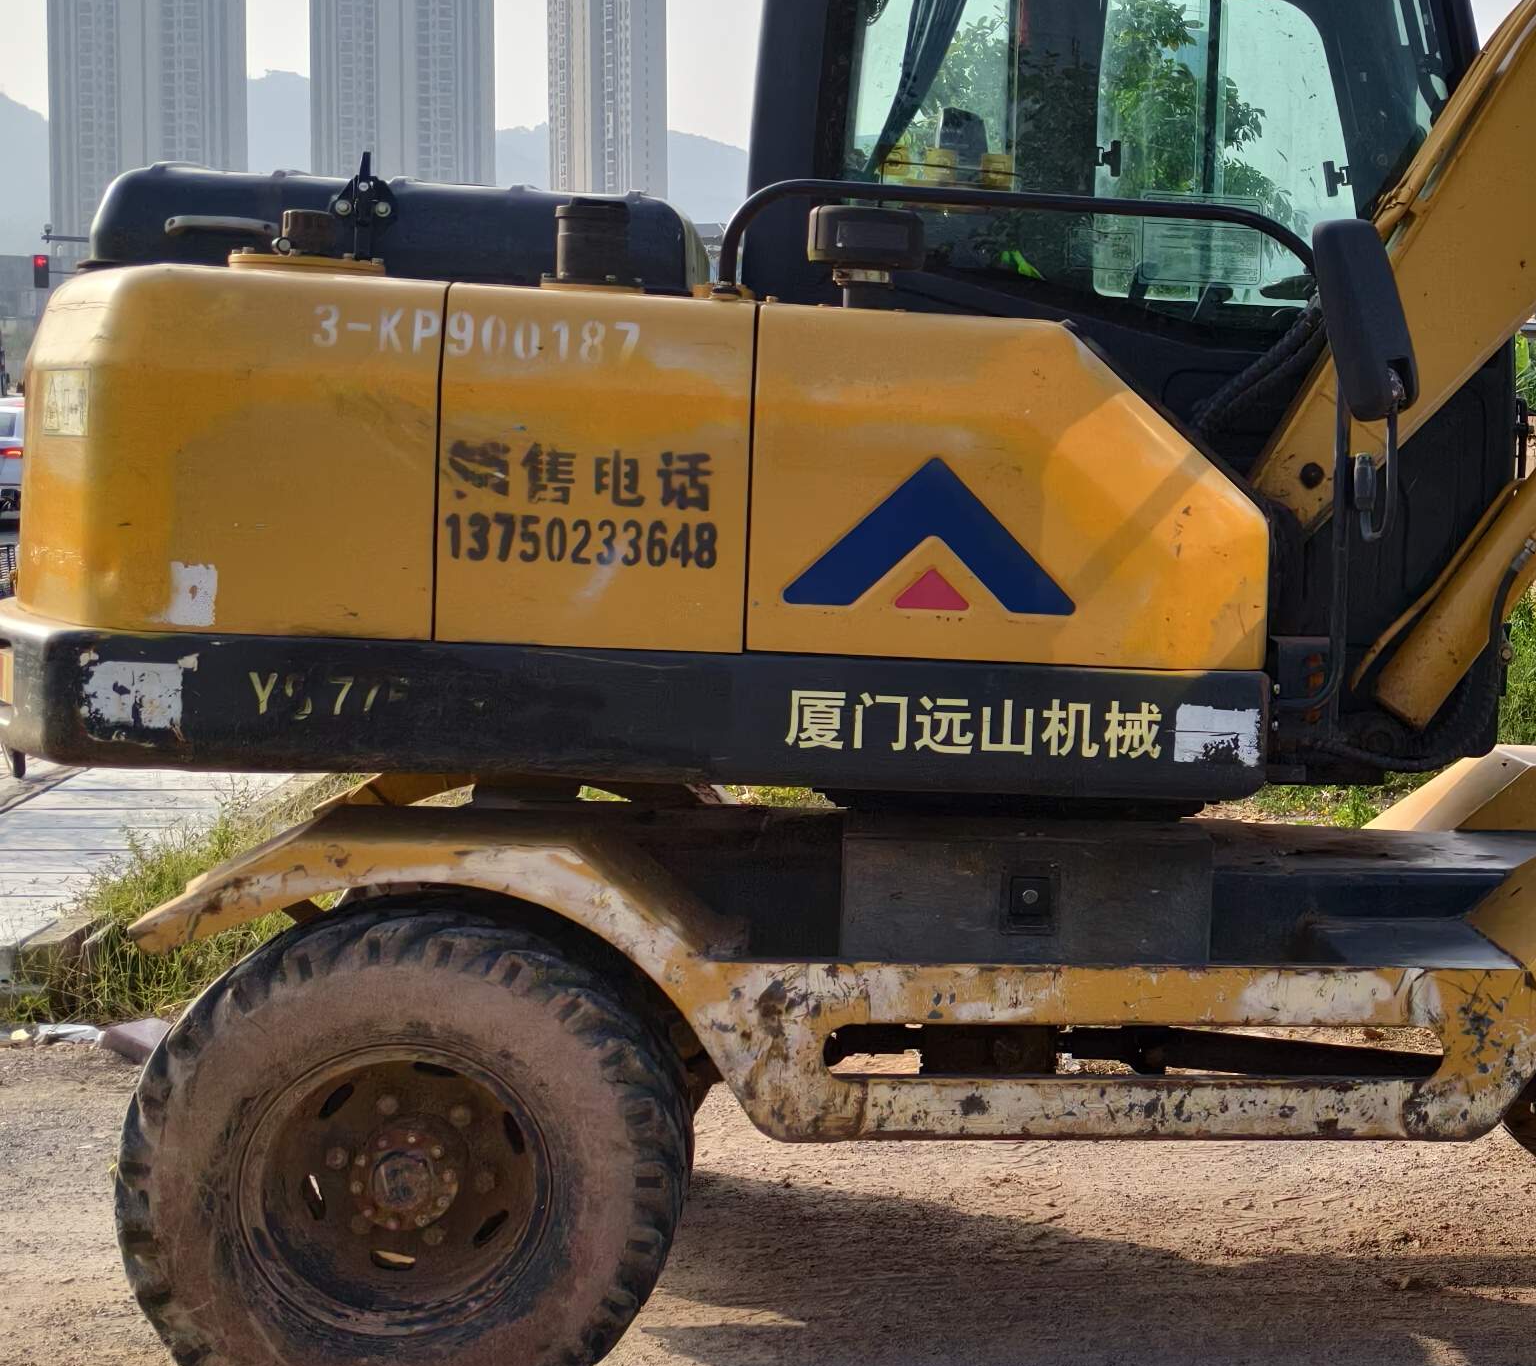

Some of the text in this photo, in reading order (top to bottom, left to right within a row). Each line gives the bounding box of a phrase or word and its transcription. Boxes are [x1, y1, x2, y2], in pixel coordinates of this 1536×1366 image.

[312, 303, 641, 363] 3-KP900187
[445, 511, 718, 569] 13750233648
[784, 689, 1163, 760] 厦门远山机械
